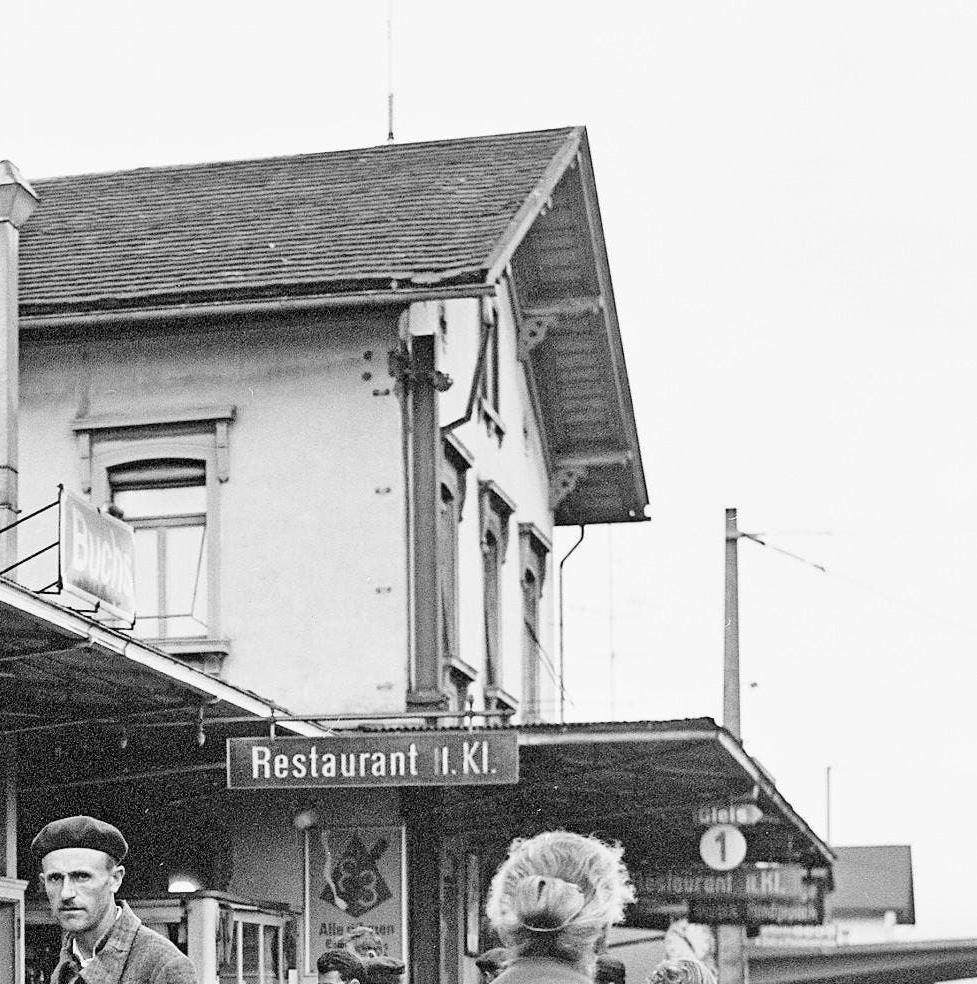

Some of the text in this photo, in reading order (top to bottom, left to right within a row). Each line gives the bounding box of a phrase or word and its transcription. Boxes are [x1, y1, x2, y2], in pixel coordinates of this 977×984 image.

[251, 742, 419, 779] Restaurant
[462, 740, 497, 775] Kl.
[714, 831, 726, 863] 1
